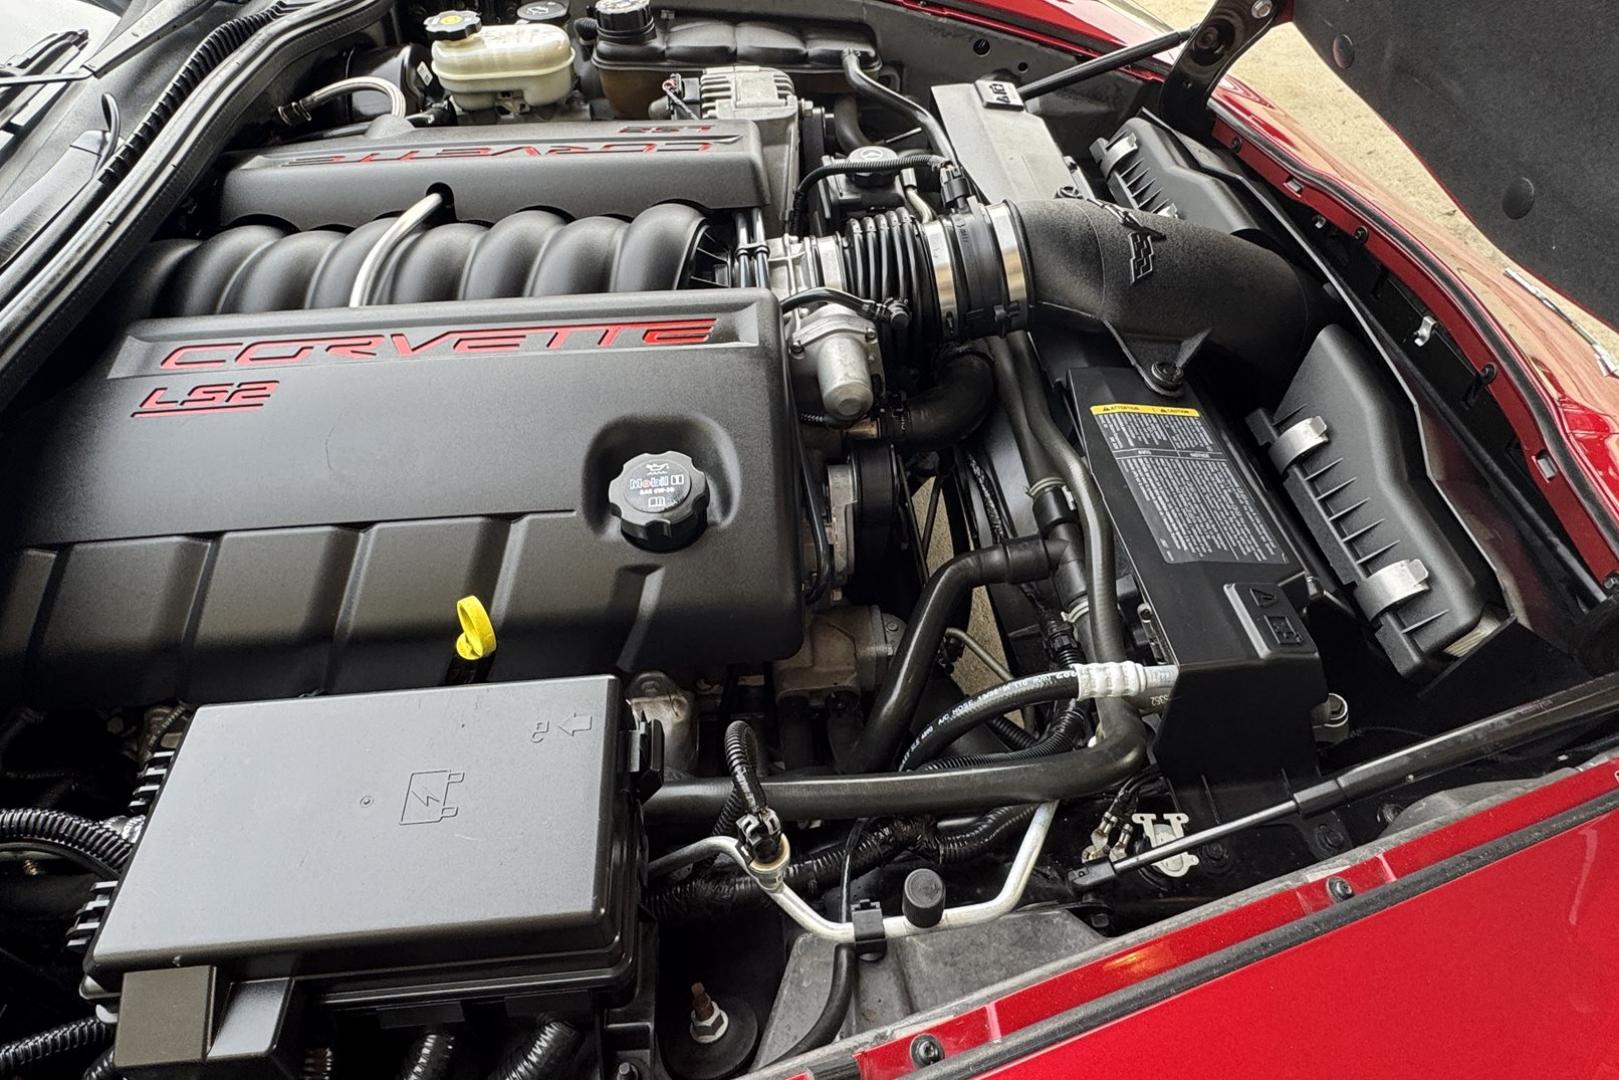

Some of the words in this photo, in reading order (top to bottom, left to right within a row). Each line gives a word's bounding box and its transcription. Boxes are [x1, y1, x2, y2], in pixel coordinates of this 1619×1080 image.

[281, 142, 712, 168] CORVETTE
[160, 318, 718, 370] CORVETTE
[138, 380, 280, 409] LS2
[630, 476, 668, 489] Mobil
